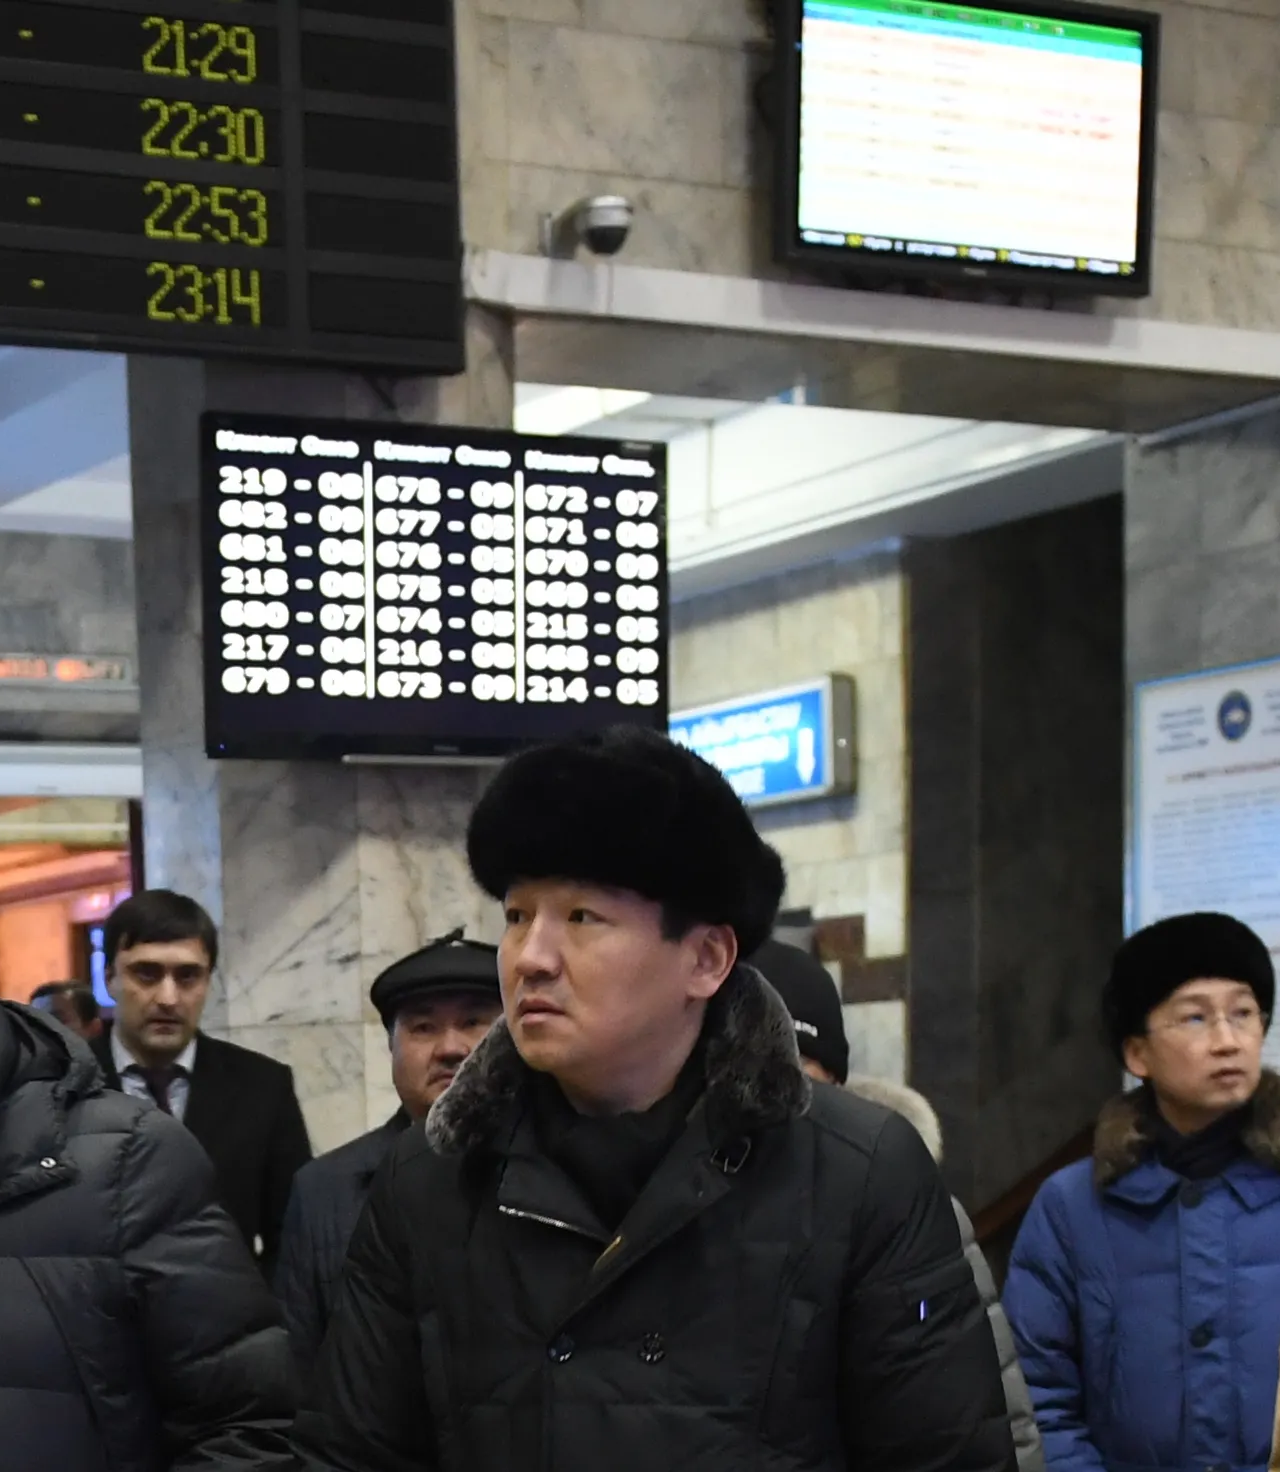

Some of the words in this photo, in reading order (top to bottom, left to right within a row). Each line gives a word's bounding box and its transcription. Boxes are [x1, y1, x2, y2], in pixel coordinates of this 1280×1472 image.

[143, 16, 257, 83] 21:29
[141, 98, 265, 165] 22:30
[144, 180, 268, 246] 22:53
[147, 262, 261, 326] 23:14
